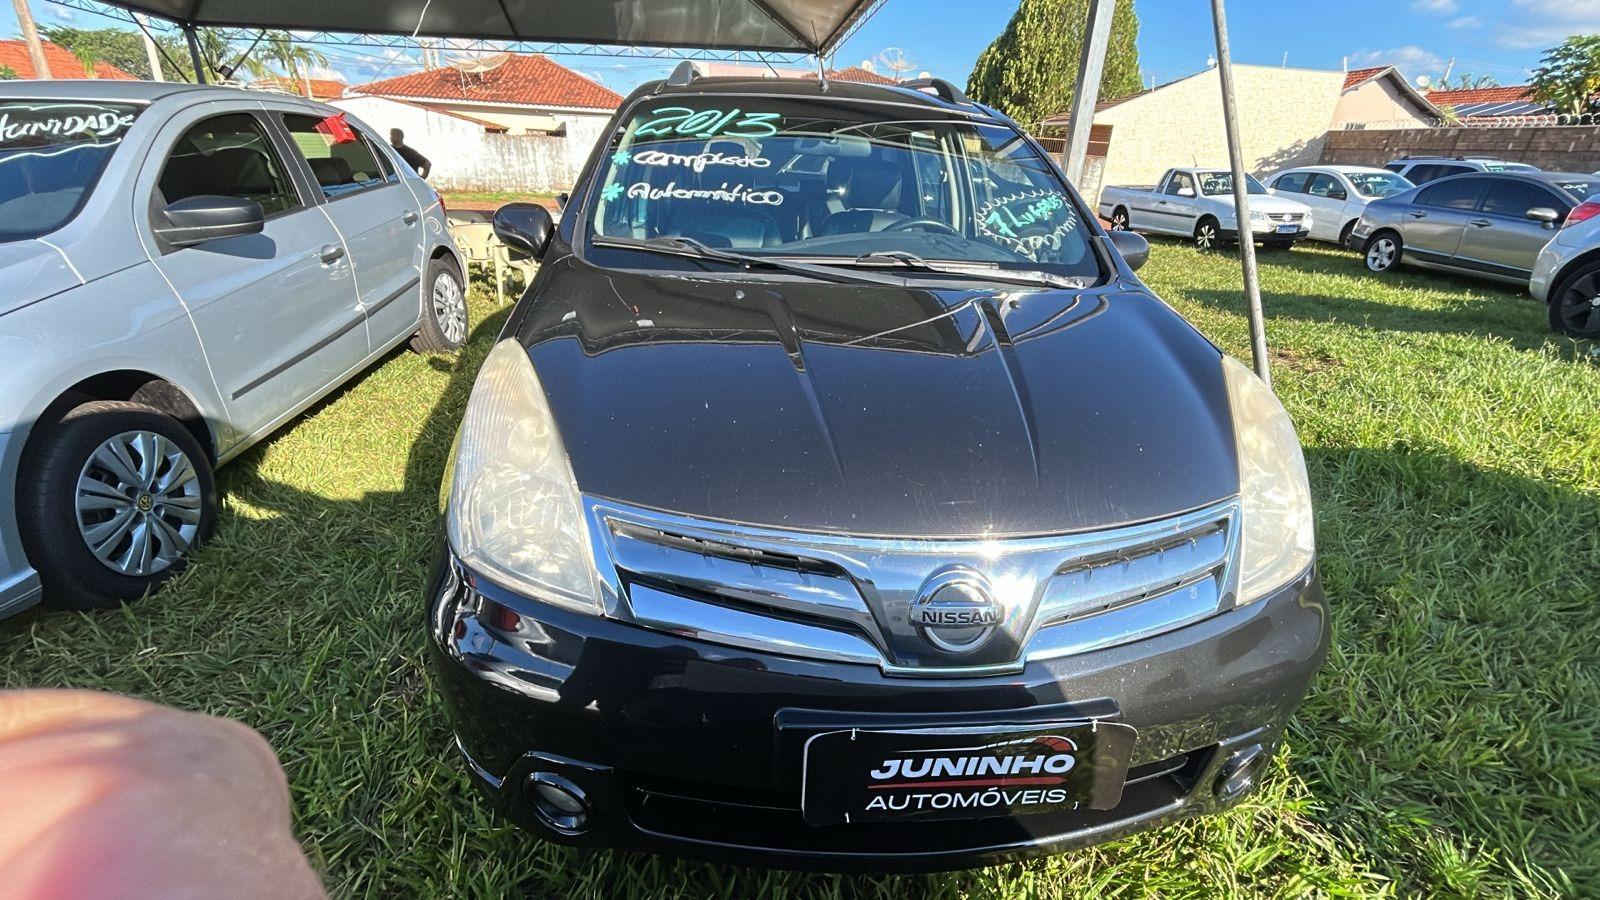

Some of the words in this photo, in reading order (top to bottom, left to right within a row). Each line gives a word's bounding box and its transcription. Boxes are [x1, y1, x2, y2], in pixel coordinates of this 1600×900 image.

[634, 106, 781, 138] 2013
[921, 610, 997, 624] NISSAN
[870, 753, 1076, 780] JUNINHO
[865, 787, 1067, 811] AUTOMÓVEIS
